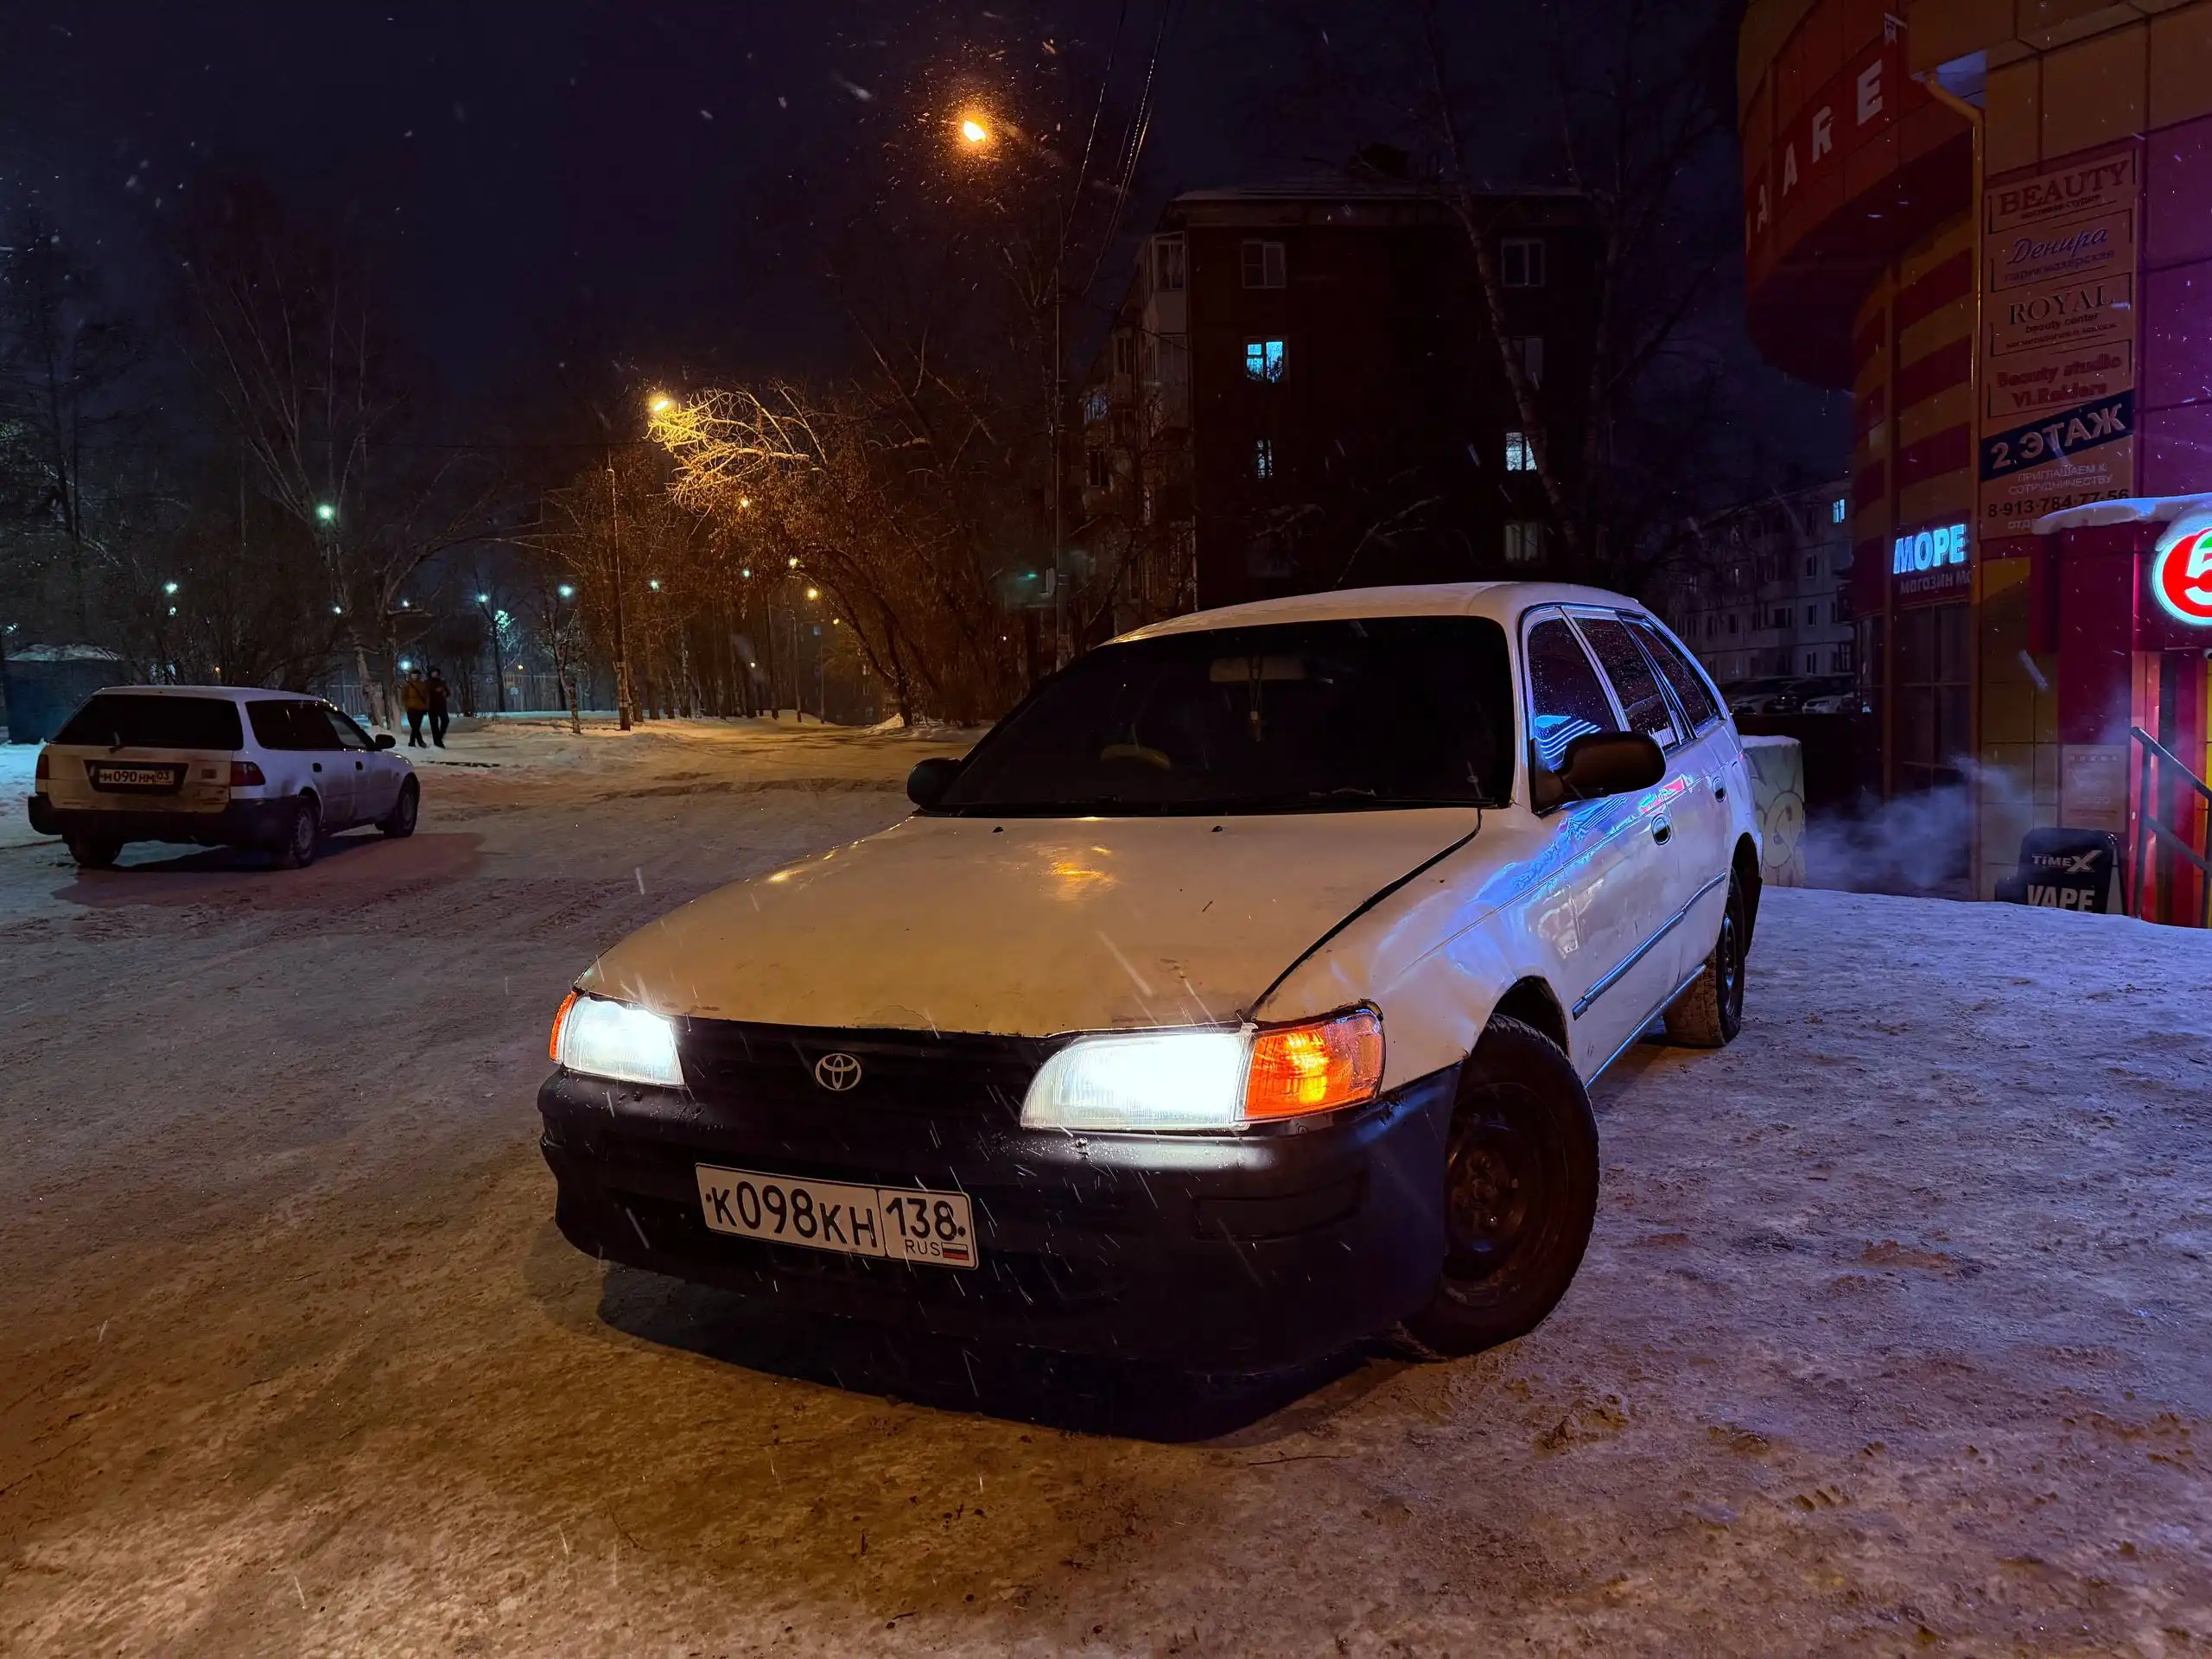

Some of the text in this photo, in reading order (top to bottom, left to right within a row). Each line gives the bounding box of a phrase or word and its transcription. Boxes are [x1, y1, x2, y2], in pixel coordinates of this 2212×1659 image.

[1999, 159, 2131, 216] BEAUTY
[2007, 227, 2110, 265] Денира
[2009, 284, 2114, 325] ROYAL
[2025, 312, 2099, 334] beauty center
[1997, 353, 2122, 388] Beauty studio
[1991, 403, 2126, 470] 2 ЭТАЖ
[2009, 474, 2113, 495] СОТРУДНИЧЕСТВУ
[2018, 464, 2094, 482] ПРИГЛАШАЕМ
[1892, 524, 1966, 575] МОРЕ
[2027, 884, 2096, 912] VAPE
[710, 1180, 957, 1249] К098КН 138
[905, 1239, 941, 1257] RUS
